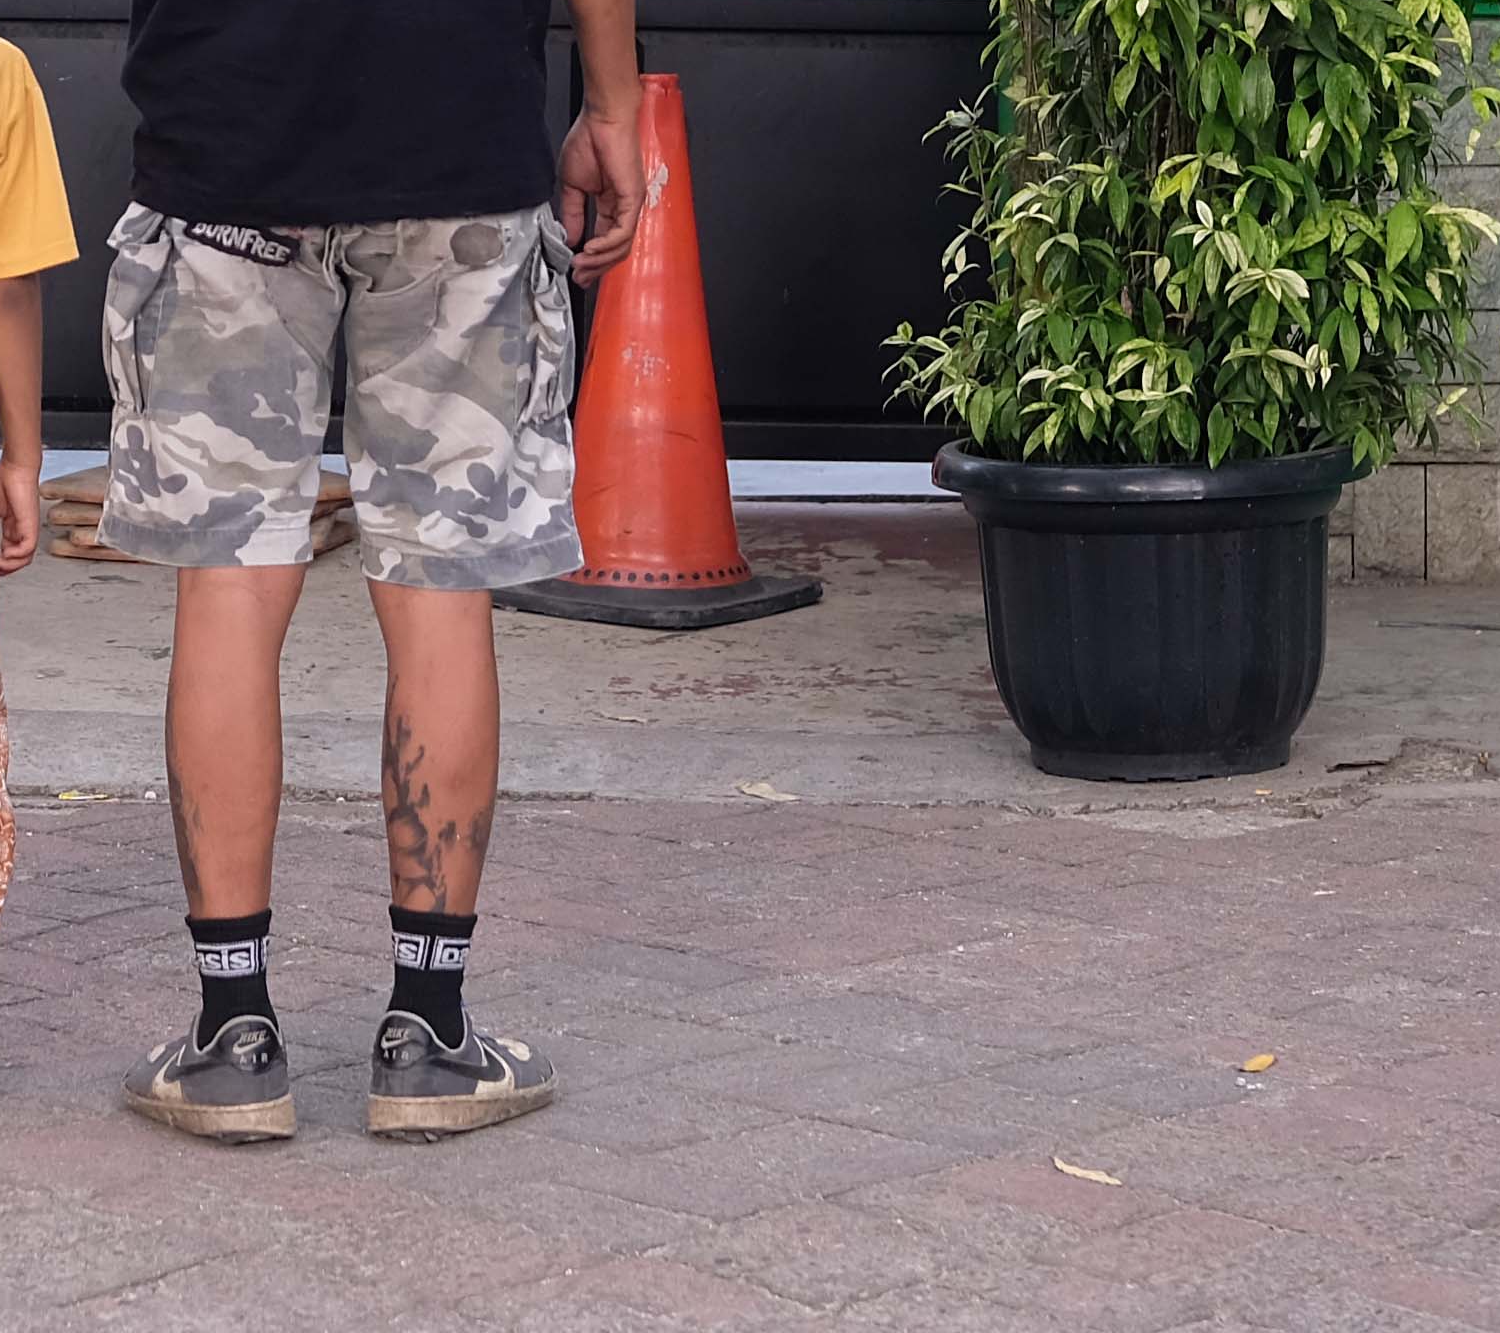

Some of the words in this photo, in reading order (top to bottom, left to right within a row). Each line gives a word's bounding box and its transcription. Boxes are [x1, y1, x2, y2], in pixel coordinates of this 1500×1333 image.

[238, 1030, 267, 1043] NIKE
[385, 1027, 411, 1039] NIKE
[239, 1052, 269, 1064] AIR
[382, 1050, 410, 1061] AIR
